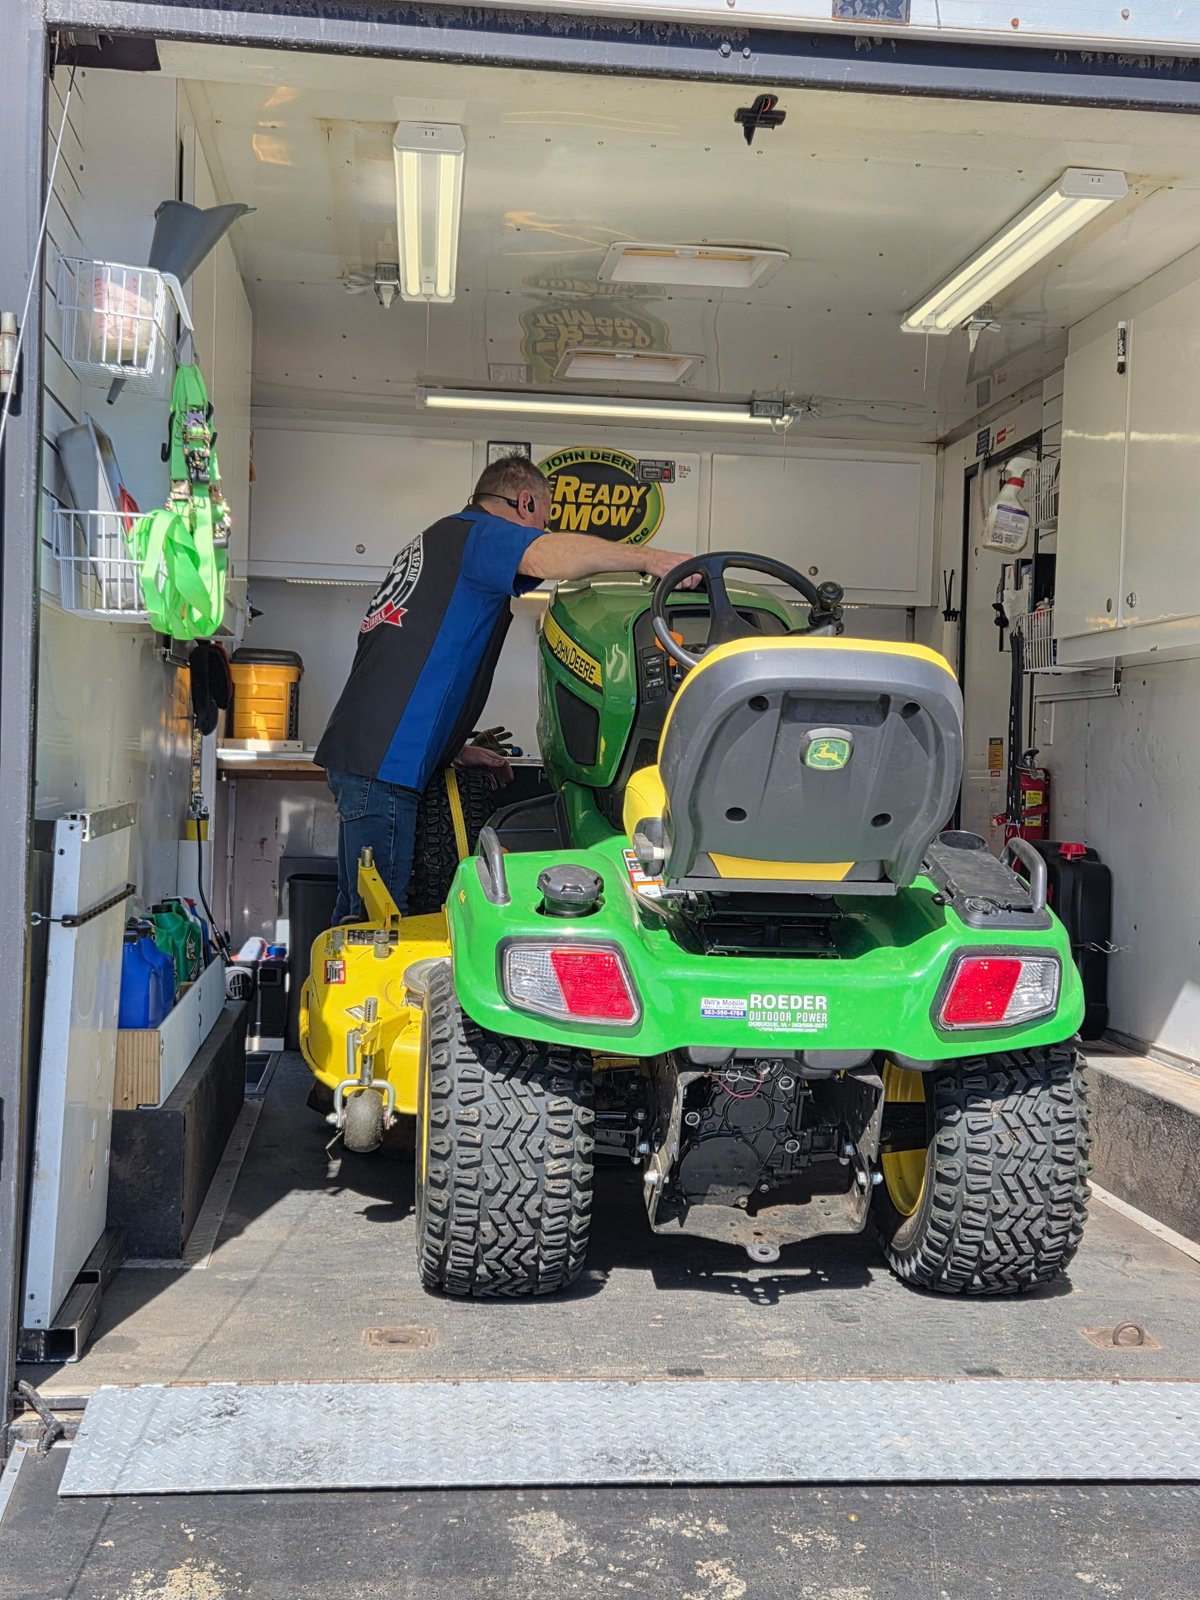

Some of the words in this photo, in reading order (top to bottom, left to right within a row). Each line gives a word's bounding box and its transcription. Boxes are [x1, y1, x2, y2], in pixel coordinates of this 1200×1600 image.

[545, 450, 585, 471] JOHN
[554, 475, 647, 506] READY
[559, 503, 635, 532] MOW
[406, 551, 422, 582] REPAIR
[553, 637, 571, 667] JOHN
[569, 646, 597, 682] DEERE
[703, 998, 721, 1006] Bill's
[722, 999, 745, 1007] Mobile
[749, 994, 827, 1010] ROEDER
[749, 1011, 791, 1022] OUTDOOR
[796, 1012, 827, 1023] POWER
